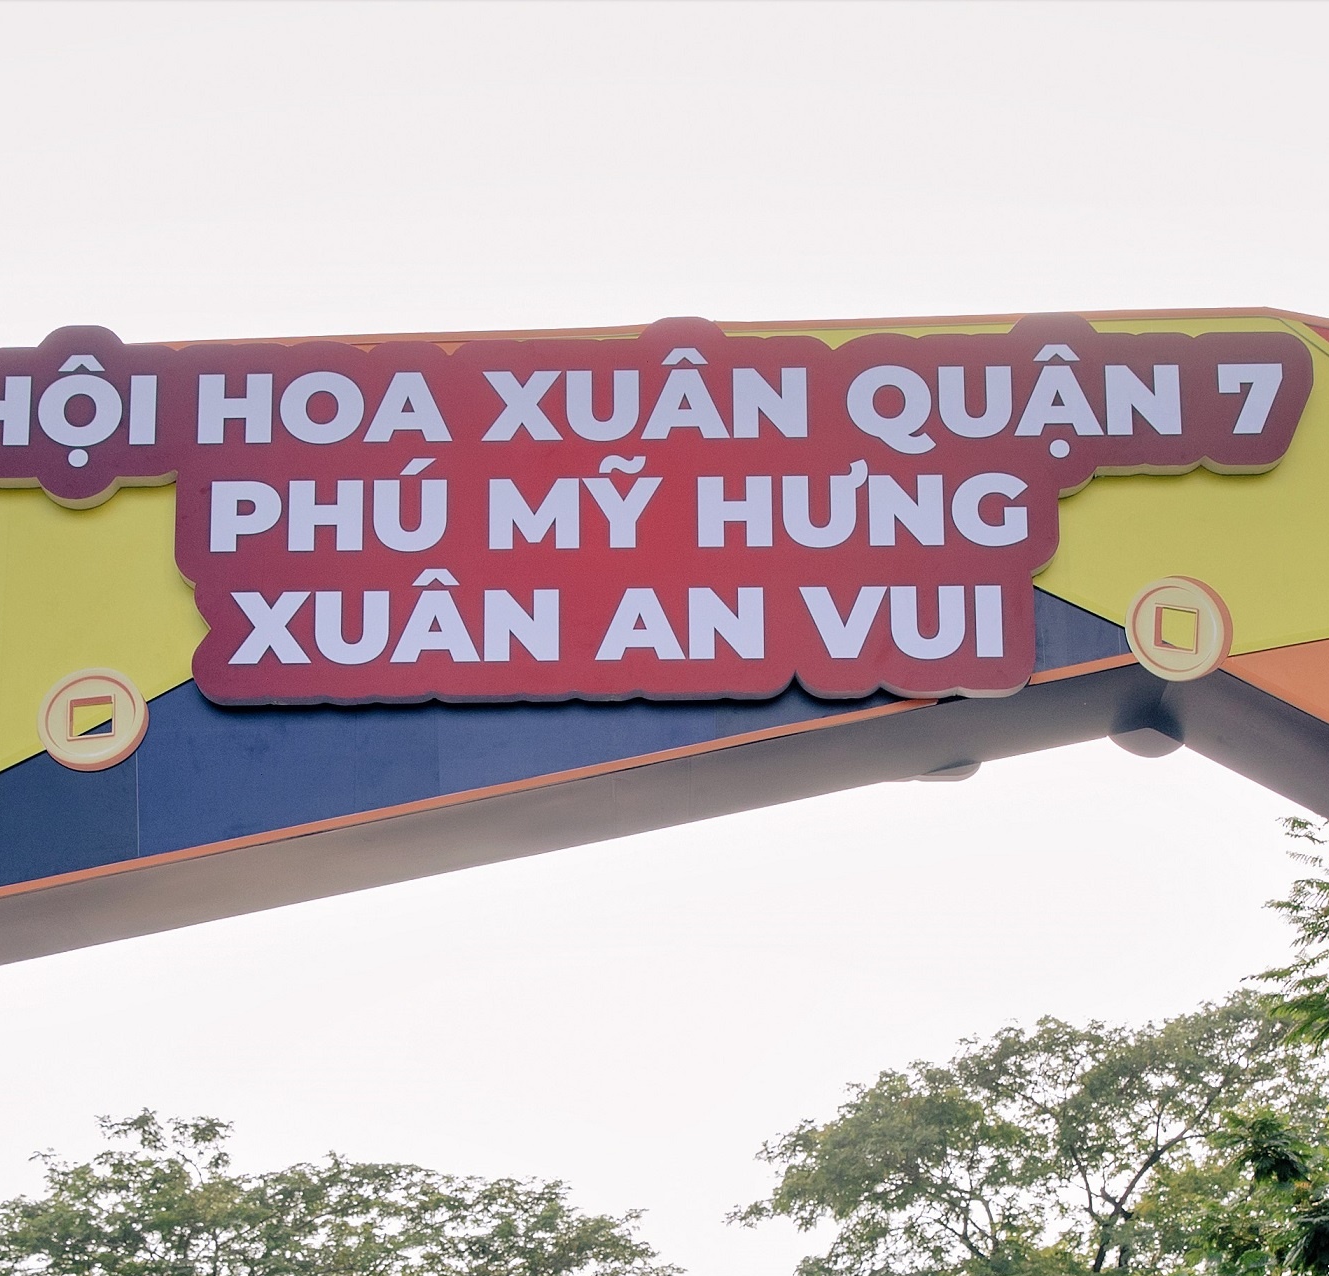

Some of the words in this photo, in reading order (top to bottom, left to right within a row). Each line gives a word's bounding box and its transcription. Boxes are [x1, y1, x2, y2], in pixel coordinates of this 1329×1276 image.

[197, 371, 453, 444] HOA
[481, 347, 808, 443] XUÂN
[846, 344, 1183, 459] QUẬN
[1217, 363, 1283, 434] 7
[210, 458, 449, 552] PHÚ
[488, 455, 664, 550] MỸ
[697, 458, 1029, 548] HƯNG
[228, 569, 560, 665] XUÂN
[594, 587, 784, 661] AN
[798, 585, 1005, 659] VUI
